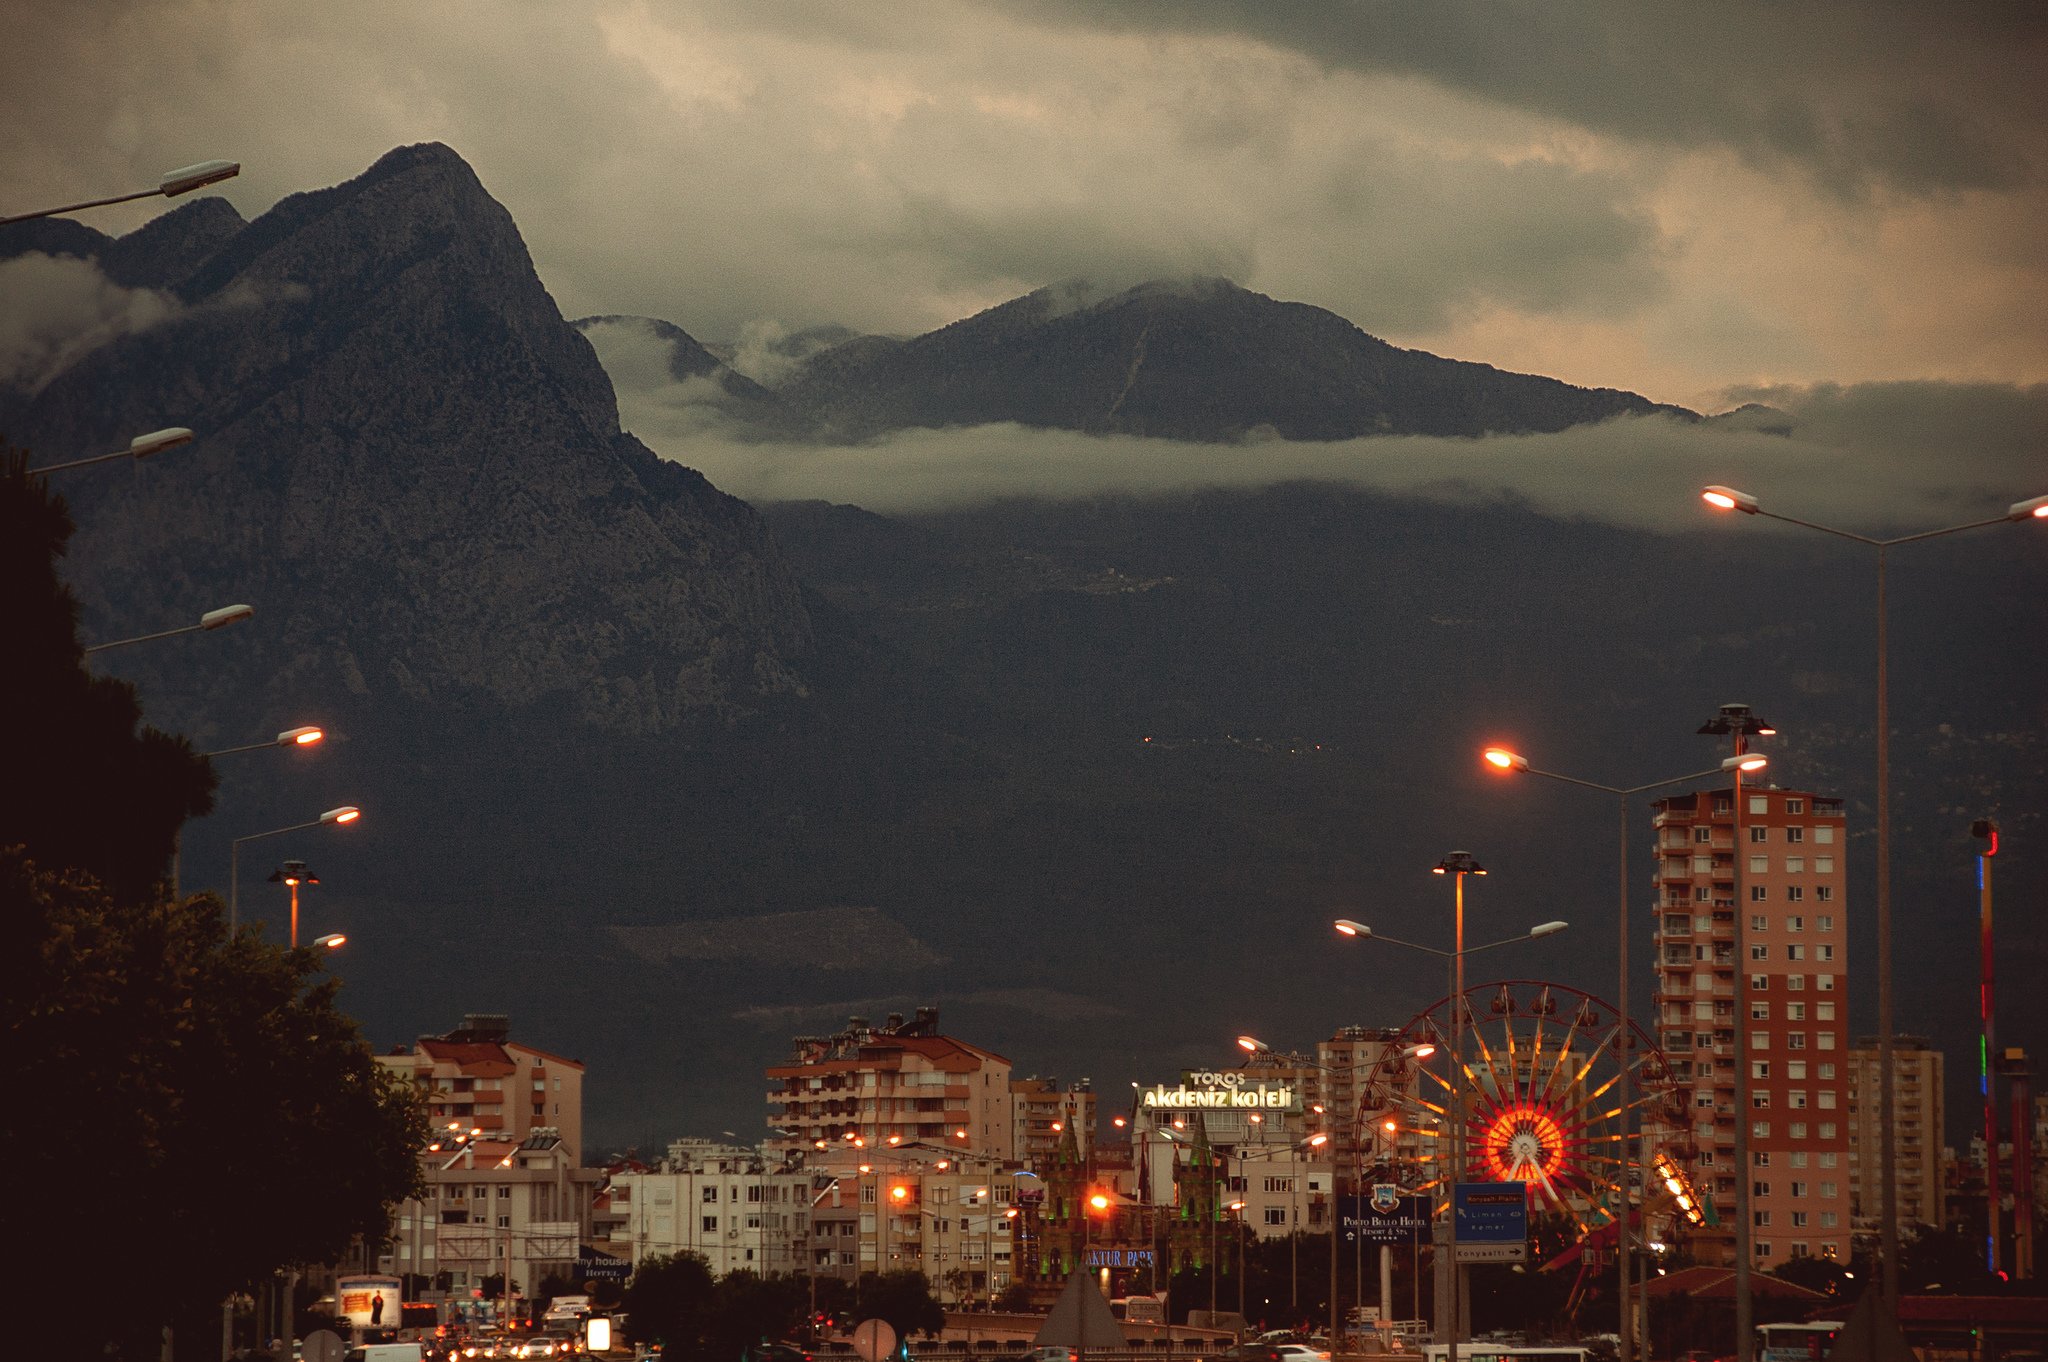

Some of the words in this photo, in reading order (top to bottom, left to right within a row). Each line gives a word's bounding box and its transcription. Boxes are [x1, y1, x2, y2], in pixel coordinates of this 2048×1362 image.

[1400, 1216, 1426, 1226] HOEL
[576, 1258, 592, 1269] my
[595, 1256, 628, 1266] house
[1086, 1249, 1121, 1266] AKTUR
